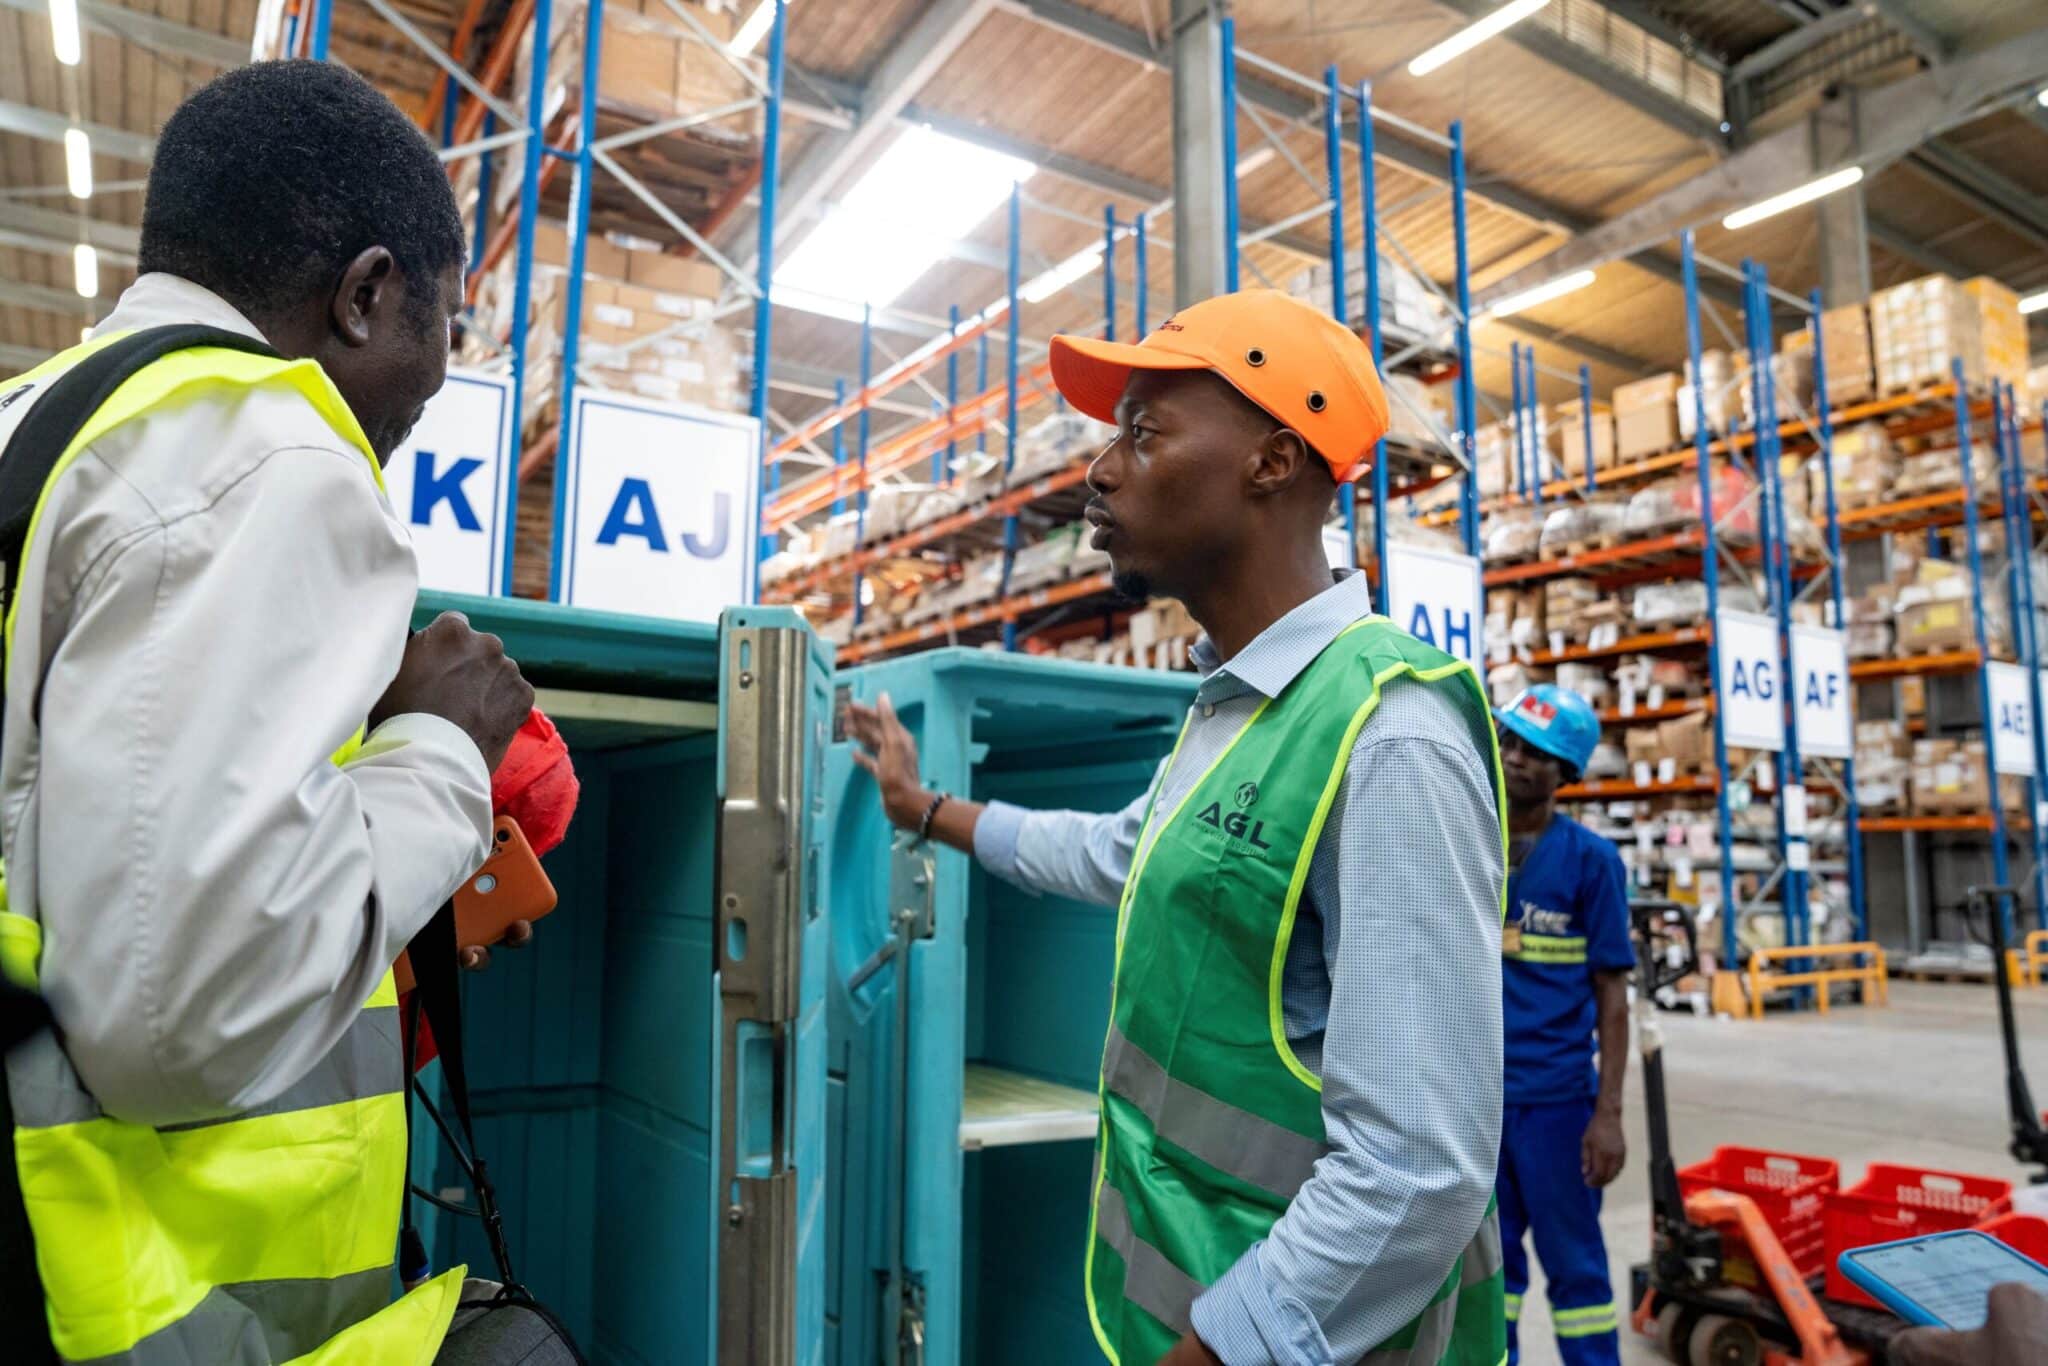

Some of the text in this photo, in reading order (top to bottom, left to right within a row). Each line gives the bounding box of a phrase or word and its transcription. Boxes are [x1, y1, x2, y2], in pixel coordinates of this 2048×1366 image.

[411, 450, 487, 533] K
[595, 476, 730, 560] AJ
[1409, 602, 1471, 659] AH
[1731, 658, 1773, 700] AG
[1804, 671, 1838, 708] AF
[1998, 702, 2026, 736] AE
[1195, 801, 1273, 851] AGL
